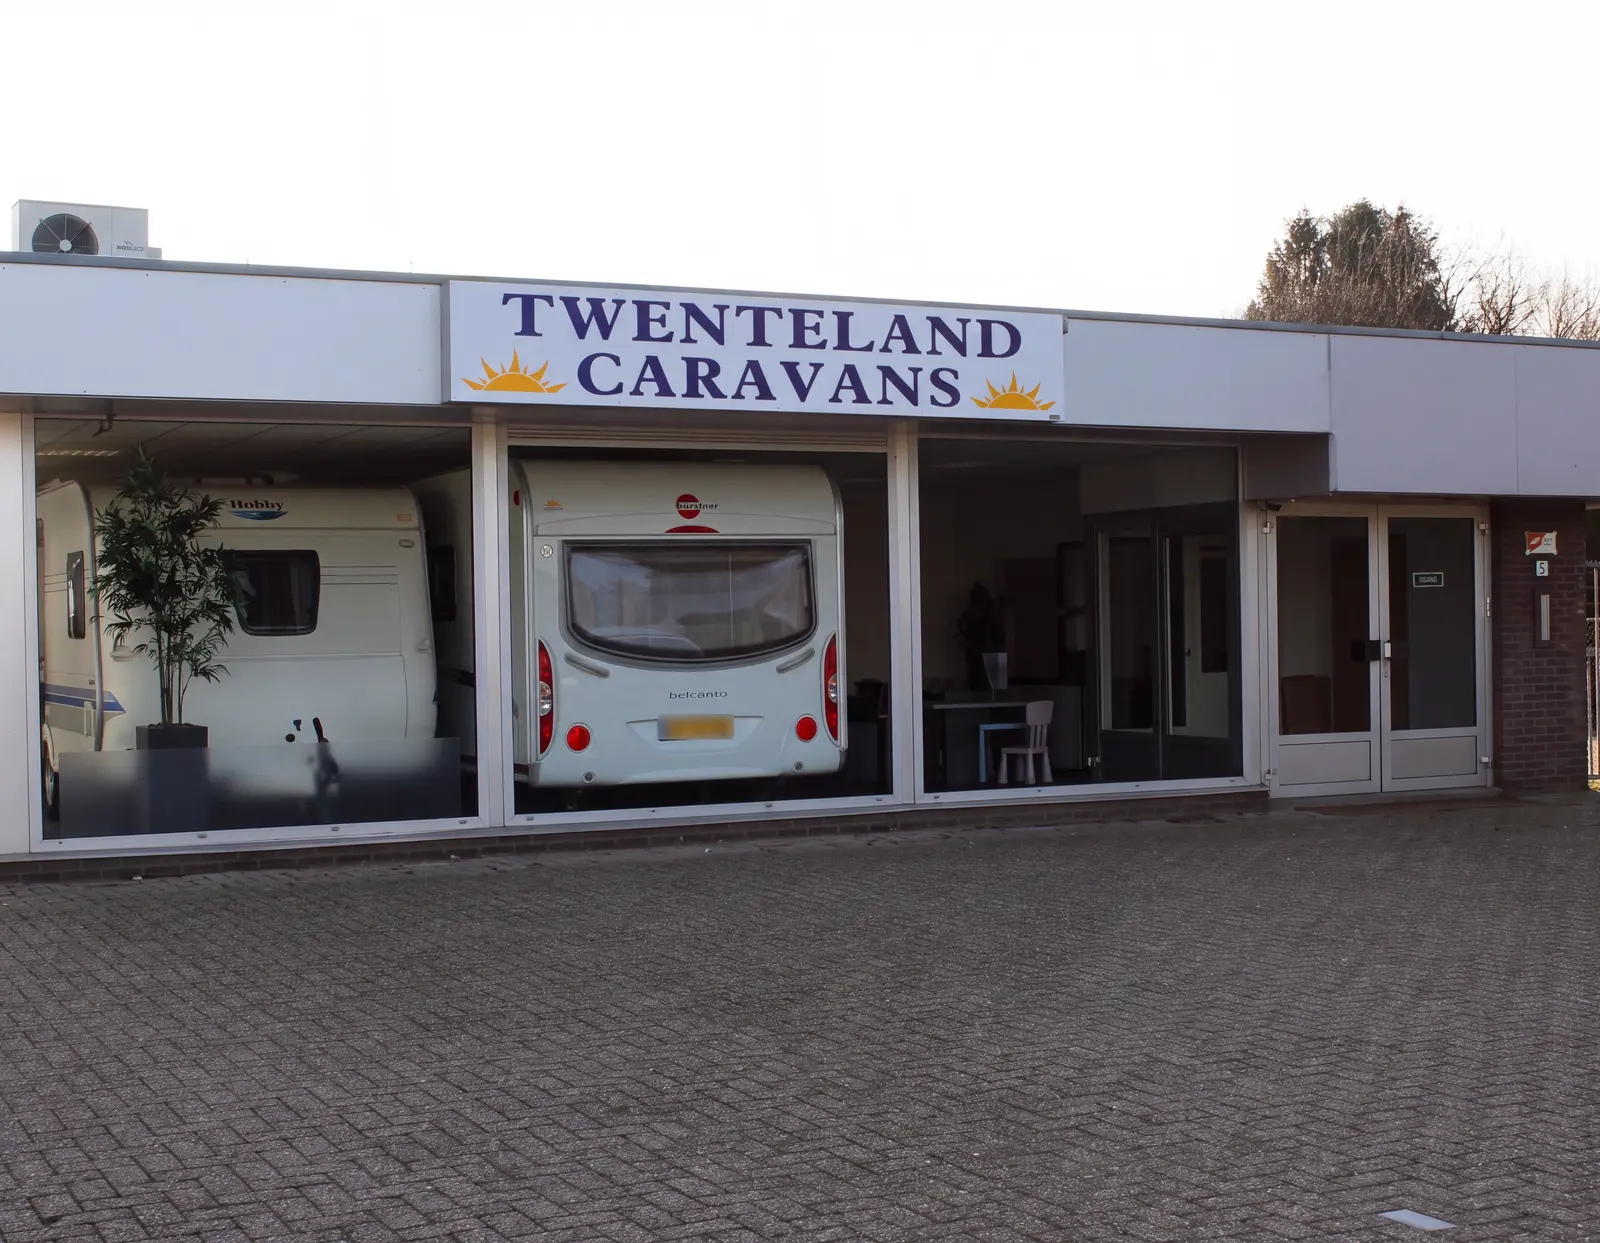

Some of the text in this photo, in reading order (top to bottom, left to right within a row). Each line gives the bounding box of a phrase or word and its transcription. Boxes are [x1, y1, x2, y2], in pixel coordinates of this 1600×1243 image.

[501, 292, 1022, 359] TWENTELAND
[576, 352, 962, 408] CARAVANS
[230, 499, 284, 511] Hobby
[669, 691, 728, 699] belcanto
